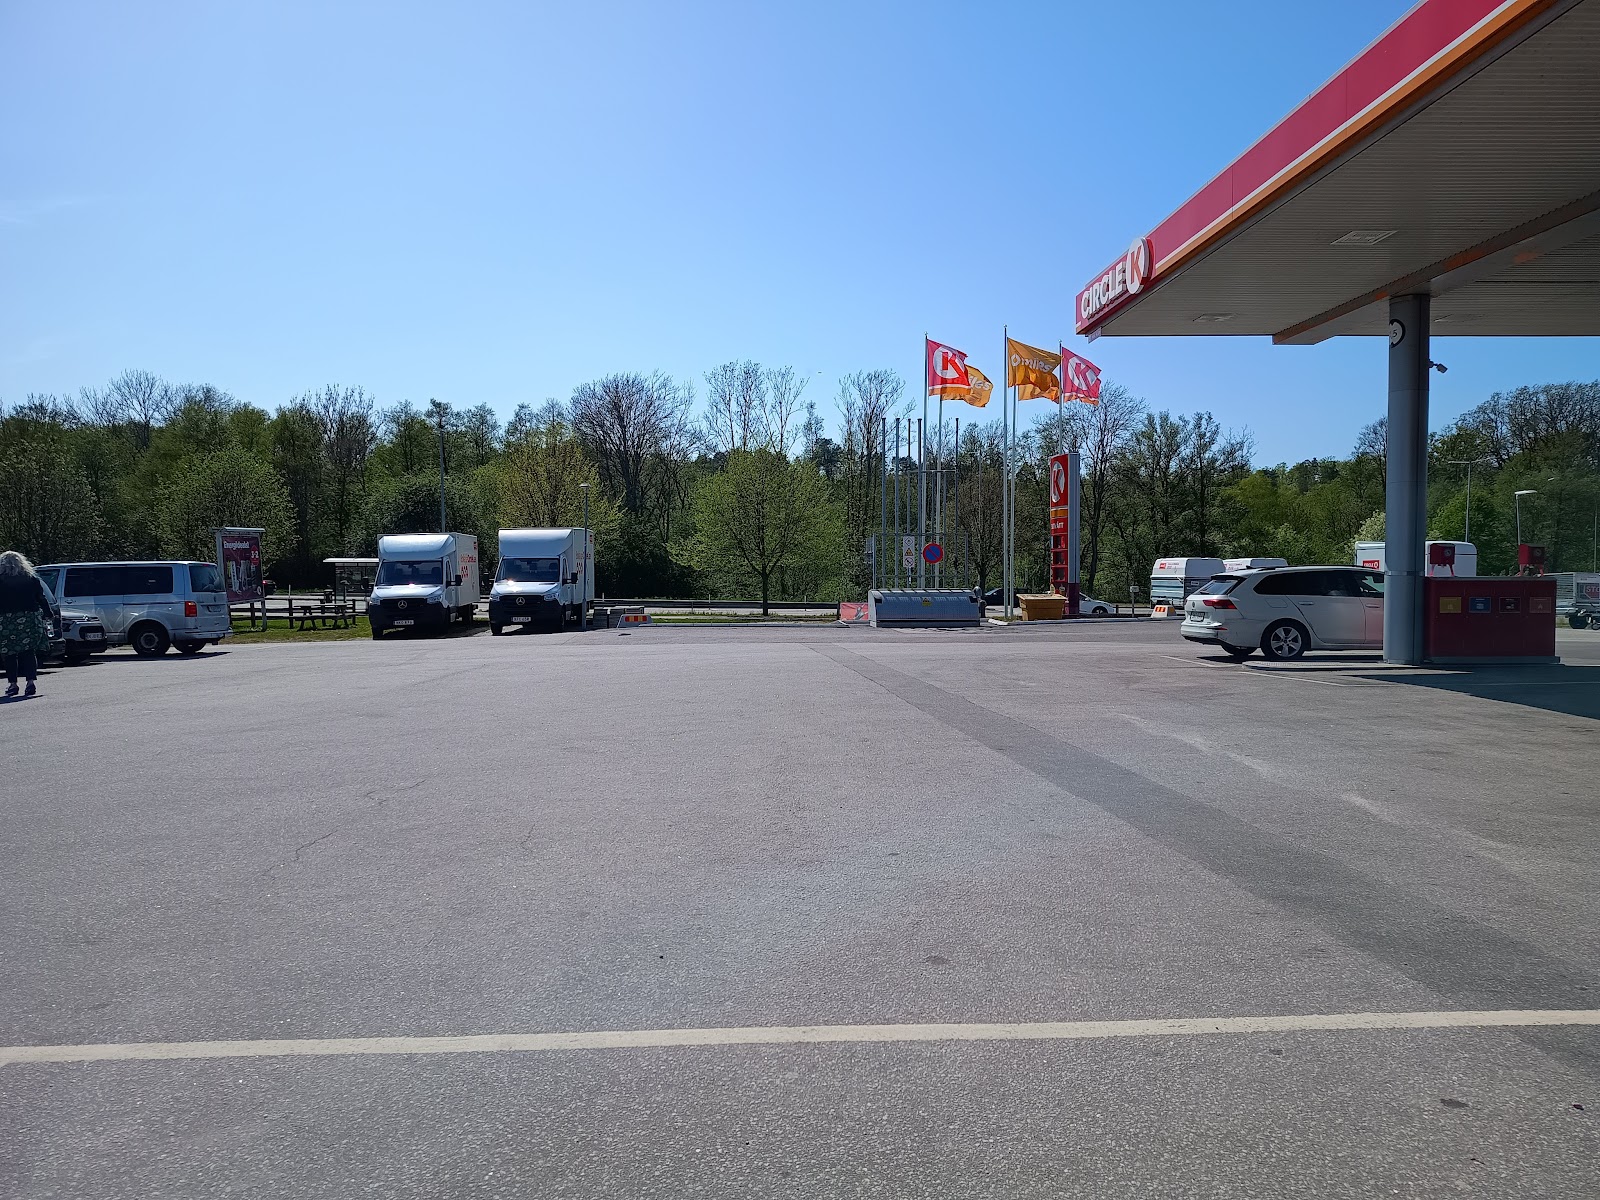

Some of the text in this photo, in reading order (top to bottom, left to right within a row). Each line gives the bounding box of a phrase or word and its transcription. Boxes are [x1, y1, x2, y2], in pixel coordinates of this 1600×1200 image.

[1081, 240, 1145, 318] CIRCLE K
[1392, 329, 1398, 338] 5
[938, 348, 965, 379] K
[1071, 359, 1095, 390] K
[1052, 464, 1064, 501] K
